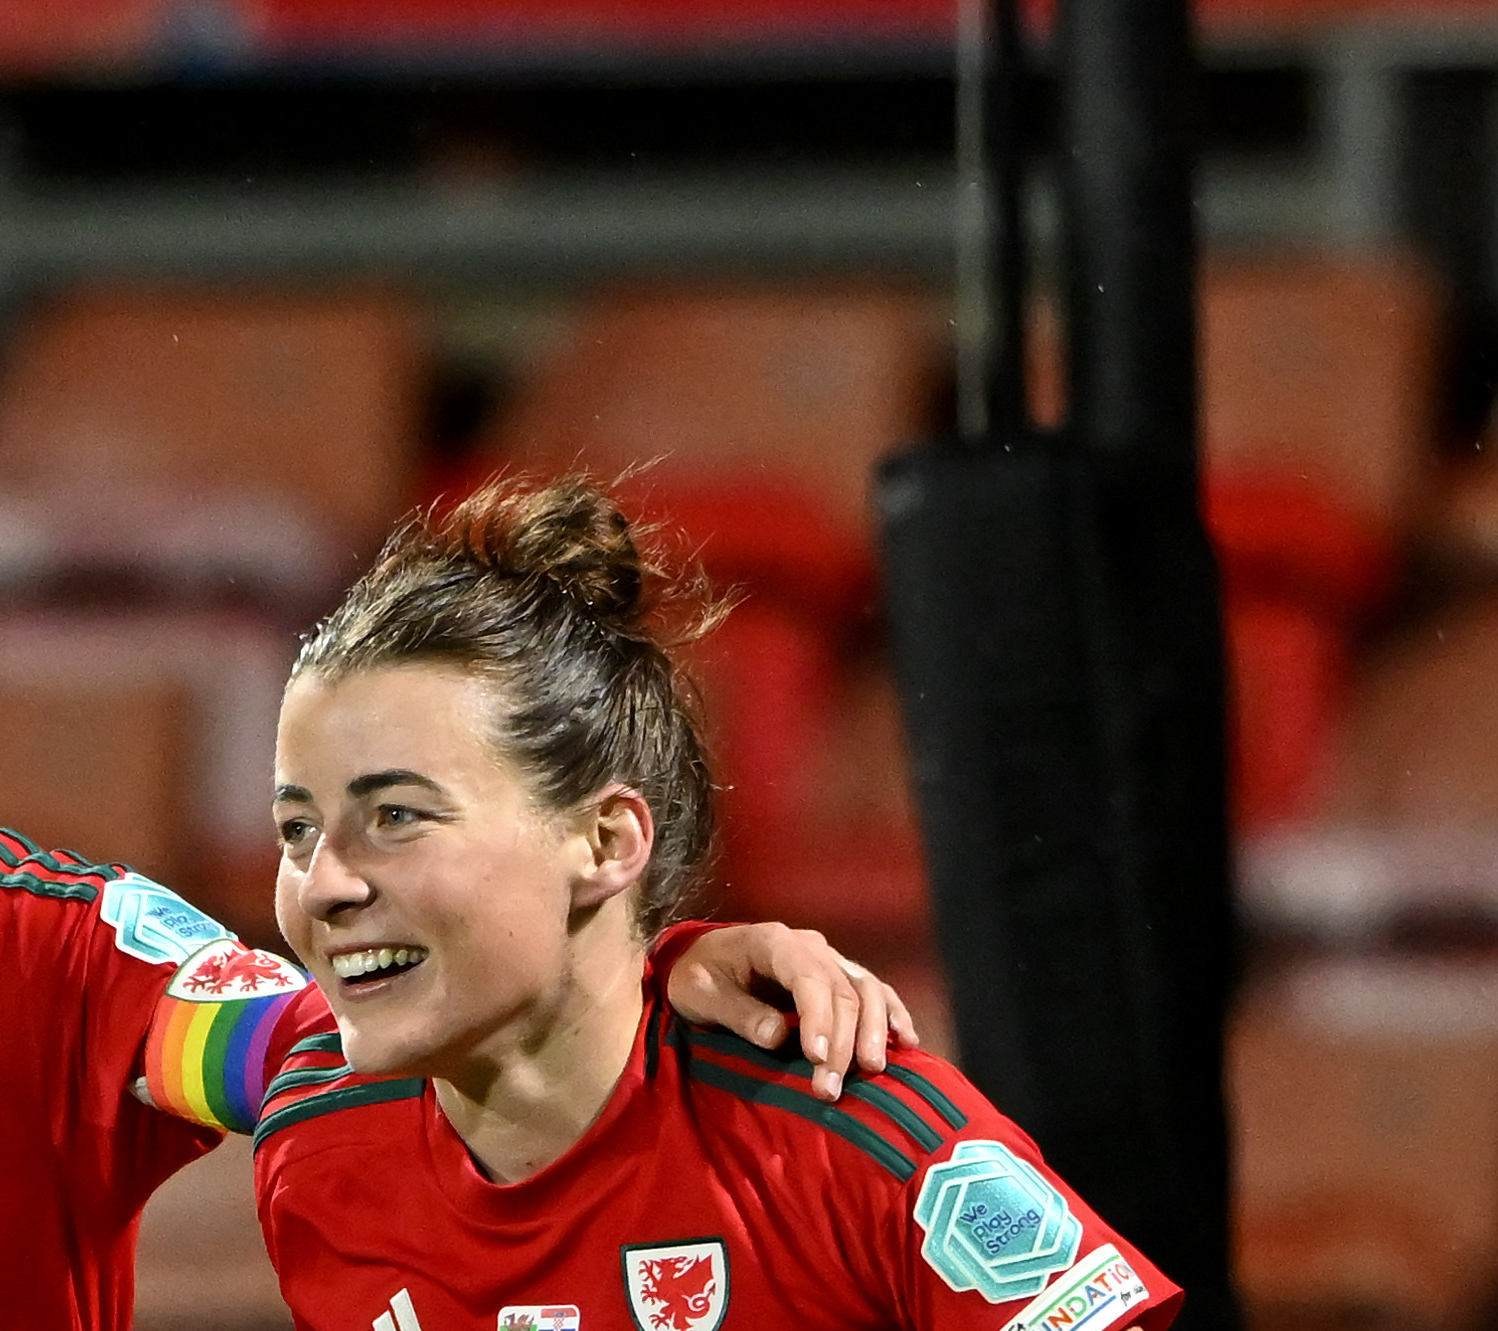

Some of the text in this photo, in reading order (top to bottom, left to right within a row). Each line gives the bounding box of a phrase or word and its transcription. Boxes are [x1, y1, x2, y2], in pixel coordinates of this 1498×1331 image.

[959, 1204, 987, 1223] We
[973, 1209, 1012, 1241] Play
[986, 1209, 1041, 1254] Strong
